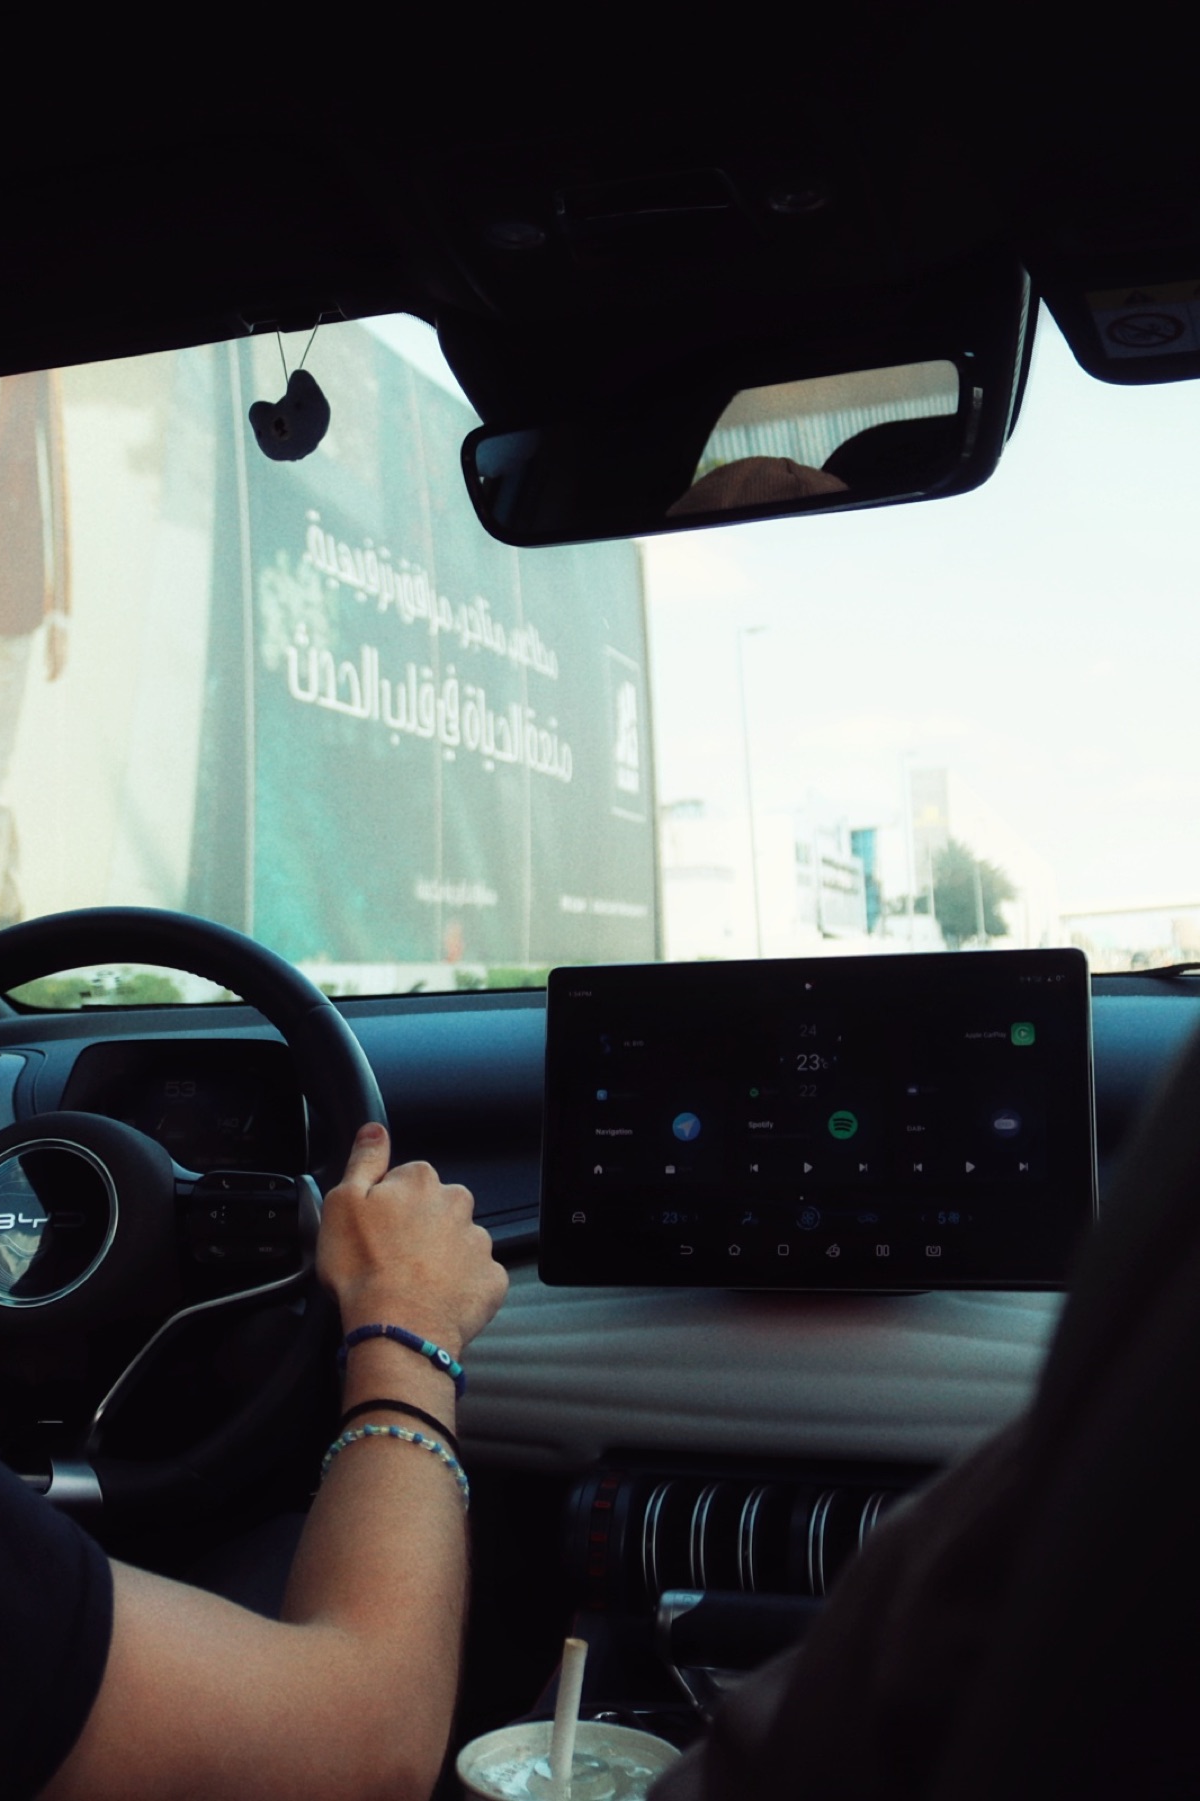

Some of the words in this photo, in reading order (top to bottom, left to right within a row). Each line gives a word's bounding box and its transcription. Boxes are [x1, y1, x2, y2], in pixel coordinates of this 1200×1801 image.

[394, 559, 453, 636] مرافق
[284, 621, 380, 721] الحدث
[380, 662, 436, 746] قلب
[436, 663, 461, 762] في
[462, 684, 524, 773] الحياة
[800, 1024, 817, 1037] 24
[164, 1081, 197, 1098] 53
[800, 1084, 817, 1097] 22
[595, 1127, 634, 1137] Navigation
[748, 1120, 775, 1130] Spotify
